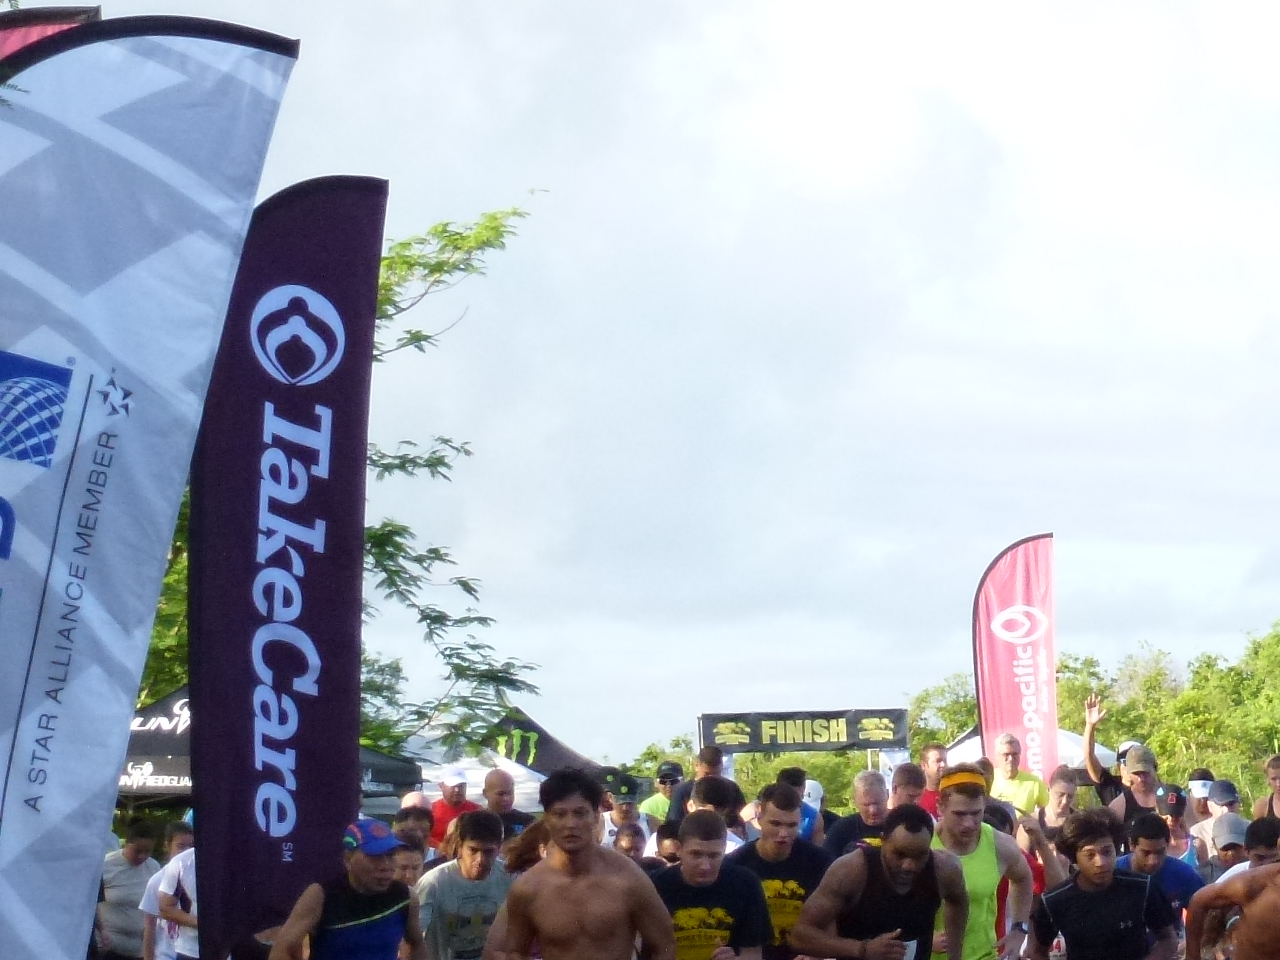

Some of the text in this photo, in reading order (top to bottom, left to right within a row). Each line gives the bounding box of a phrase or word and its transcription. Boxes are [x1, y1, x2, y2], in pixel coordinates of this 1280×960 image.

[23, 431, 119, 812] A STAR ALLIANCE MEMBER
[251, 401, 334, 838] TakeCare
[761, 718, 848, 745] FINISH
[1012, 645, 1044, 731] pacific
